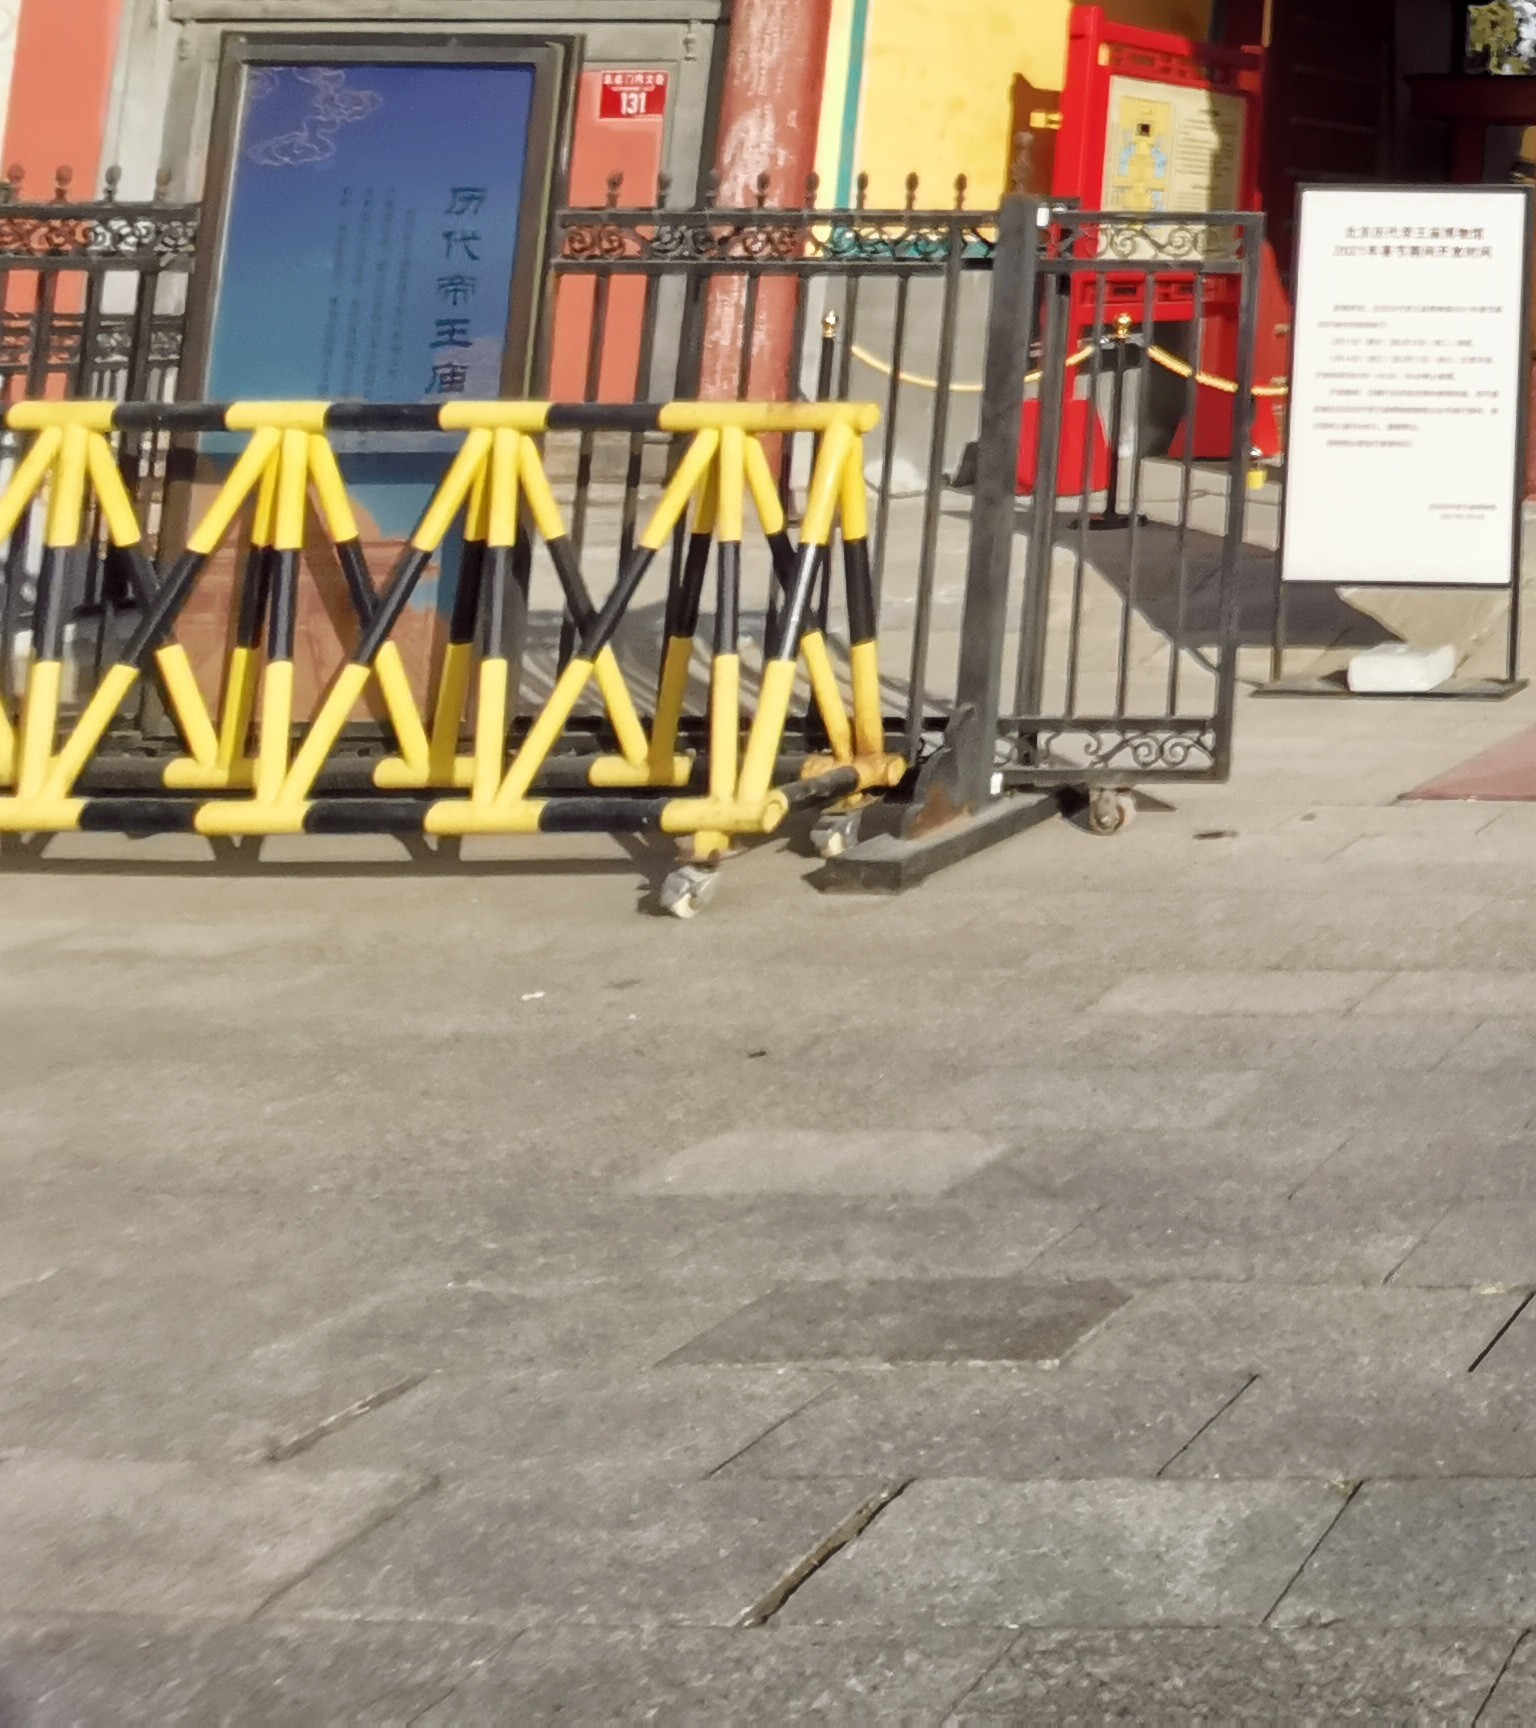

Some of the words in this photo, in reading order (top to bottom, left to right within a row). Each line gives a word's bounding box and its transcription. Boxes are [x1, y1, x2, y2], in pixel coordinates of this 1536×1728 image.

[621, 92, 647, 115] 131
[425, 187, 488, 394] 历代帝王庙
